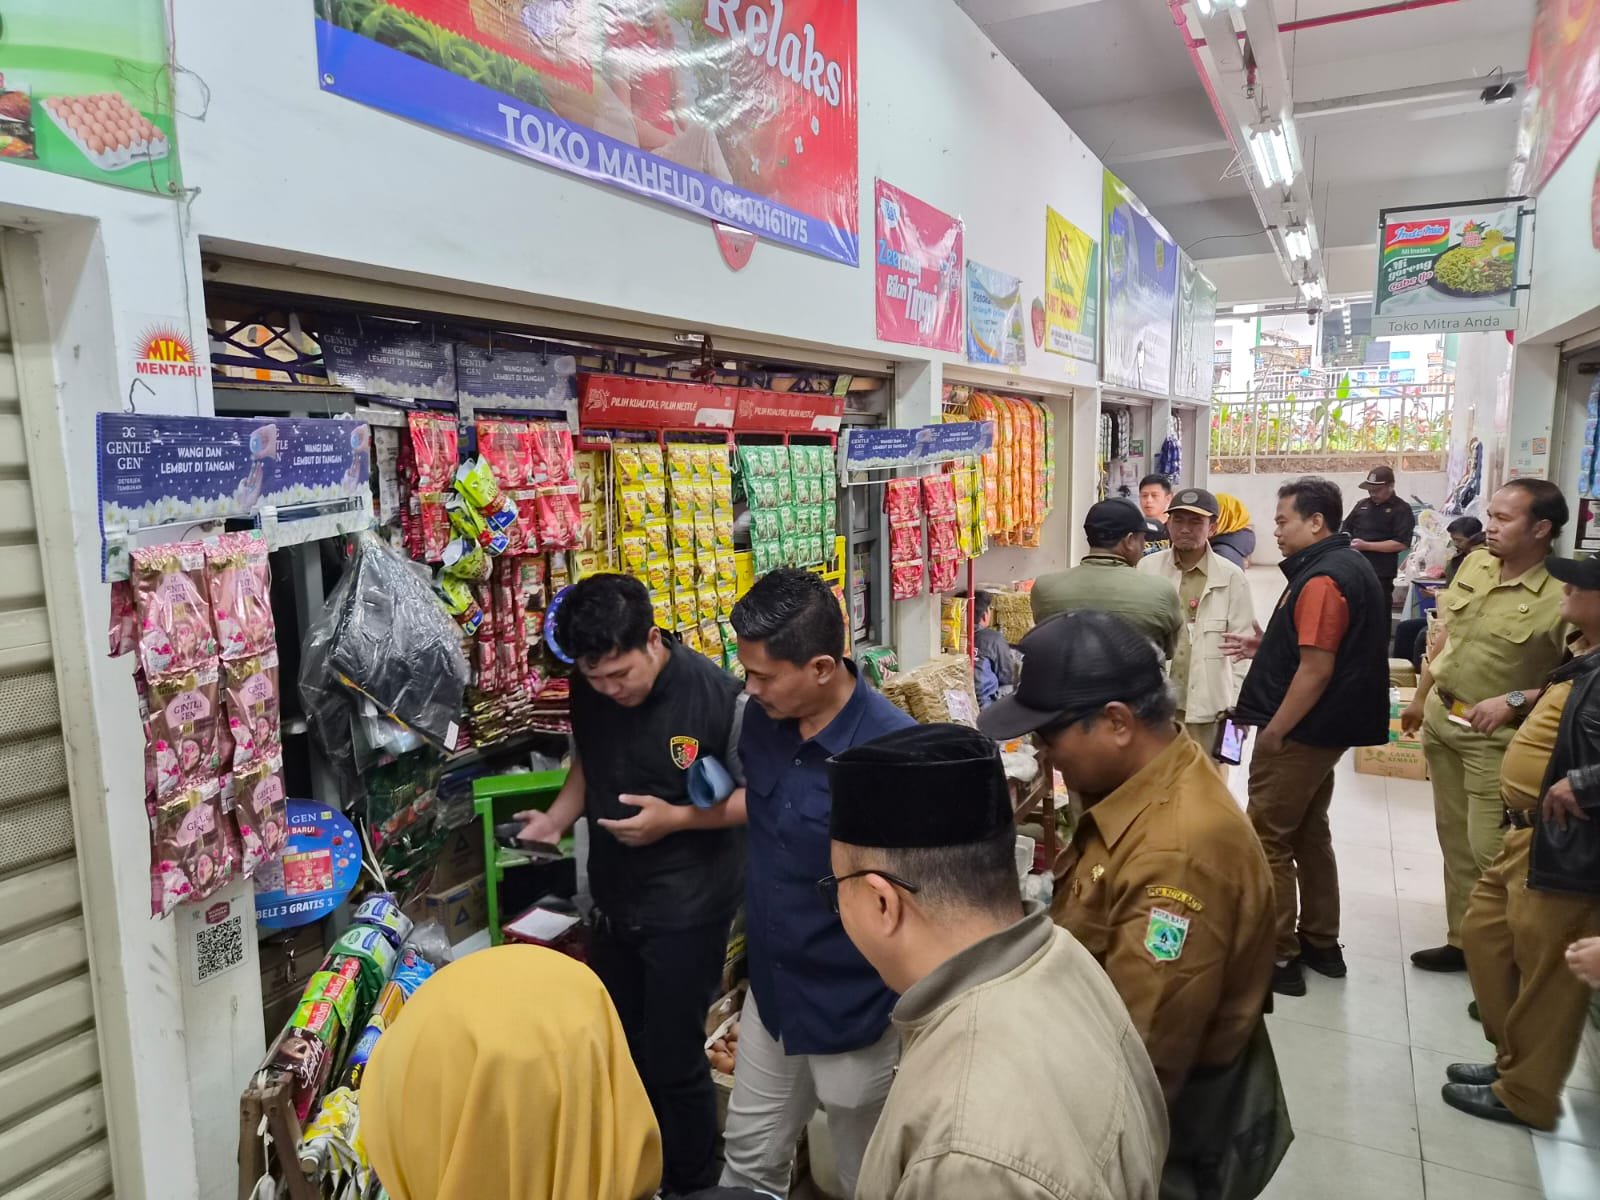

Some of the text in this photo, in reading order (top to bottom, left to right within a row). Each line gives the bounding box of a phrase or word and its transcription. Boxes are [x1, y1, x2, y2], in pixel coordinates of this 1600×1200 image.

[705, 0, 842, 106] Relaks
[498, 103, 590, 169] TOKO
[886, 275, 938, 333] Bikin Tinggi
[1388, 316, 1500, 332] Toko Mitra Anda
[323, 335, 358, 346] GENTLE
[147, 338, 190, 362] MTR
[333, 345, 353, 356] GEN
[381, 347, 420, 358] WANGI DAN
[368, 354, 395, 366] LEMBUT
[406, 360, 433, 369] TANGAN
[460, 359, 487, 368] GENTLE
[136, 362, 202, 377] MENTARI
[466, 368, 480, 376] GEN
[493, 373, 515, 381] LEMBUT
[523, 374, 545, 382] TANGAN
[610, 397, 629, 407] PILIH
[660, 400, 677, 410] PILIH
[106, 441, 152, 455] GENTLE
[178, 447, 222, 459] WANGI DAN
[304, 443, 334, 453] WANGI DAN
[117, 457, 142, 470] GEN
[293, 455, 342, 466] LEMBUT DI TANGAN
[161, 461, 235, 474] LEMBUT DI TANGAN
[291, 813, 317, 824] GEN
[291, 826, 315, 834] BARU!
[256, 897, 334, 919] BELI 3 GRATIS 1
